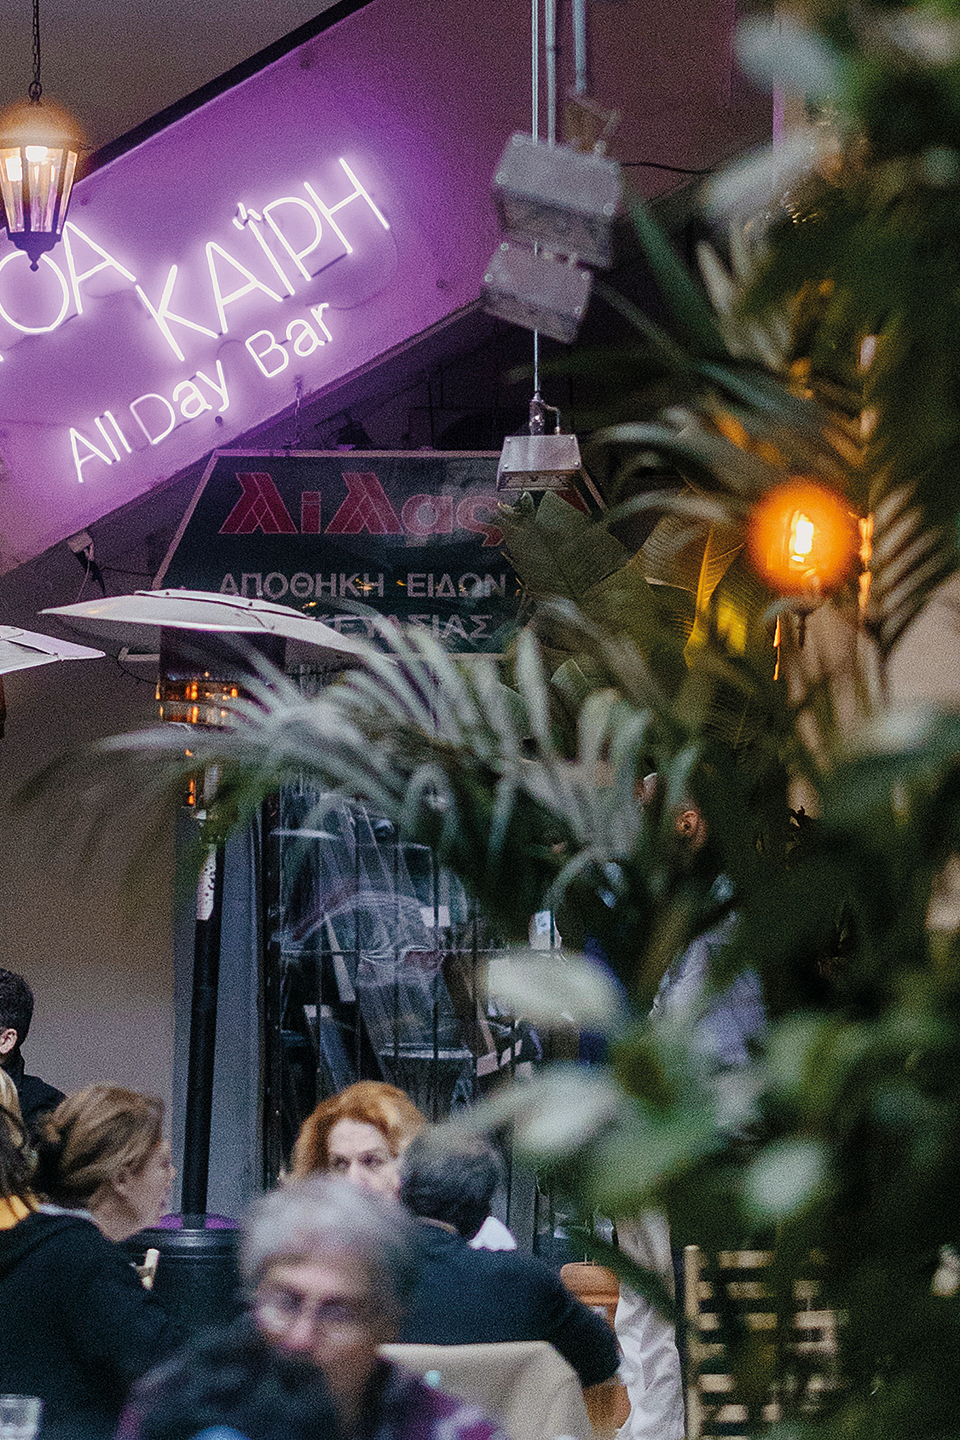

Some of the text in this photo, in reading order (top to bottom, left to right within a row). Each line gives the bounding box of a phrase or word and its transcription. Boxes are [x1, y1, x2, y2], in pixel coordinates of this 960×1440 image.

[69, 302, 333, 483] All Day Bar
[220, 572, 507, 599] ΑΠΟΘΗΚΗ ΕΙΔΩΝ
